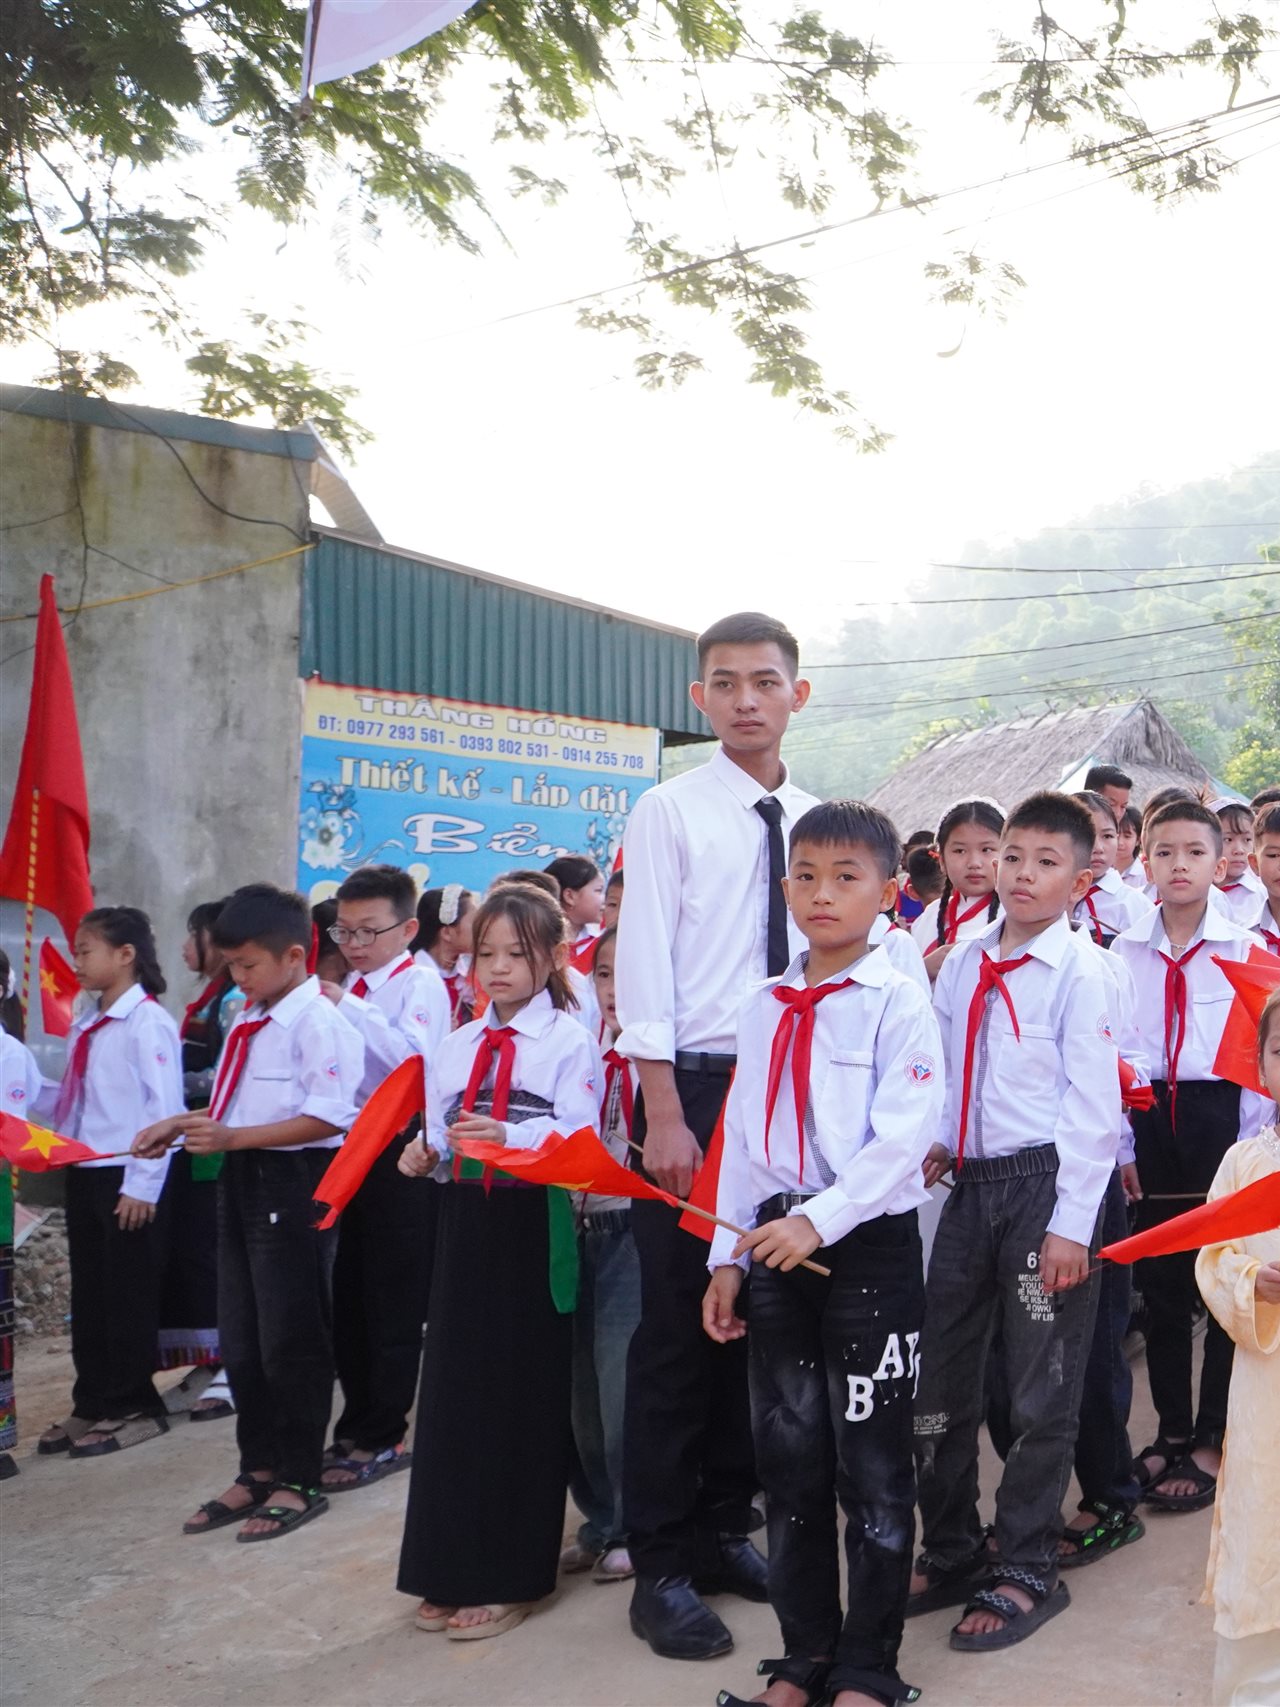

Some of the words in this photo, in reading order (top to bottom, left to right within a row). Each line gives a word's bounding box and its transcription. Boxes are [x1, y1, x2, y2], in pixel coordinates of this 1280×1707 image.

[318, 715, 341, 732] ĐT:
[346, 719, 384, 737] 0977
[389, 724, 416, 741] 293
[420, 727, 444, 744] 561
[460, 734, 493, 752] 0393
[498, 738, 522, 756] 802
[527, 743, 549, 758] 531
[562, 746, 592, 764] 0914
[595, 751, 619, 767] 255
[622, 754, 644, 769] 708
[336, 755, 428, 794] Thiết
[437, 767, 484, 801] kế
[1026, 1251, 1041, 1269] 6
[1031, 1312, 1042, 1321] MY
